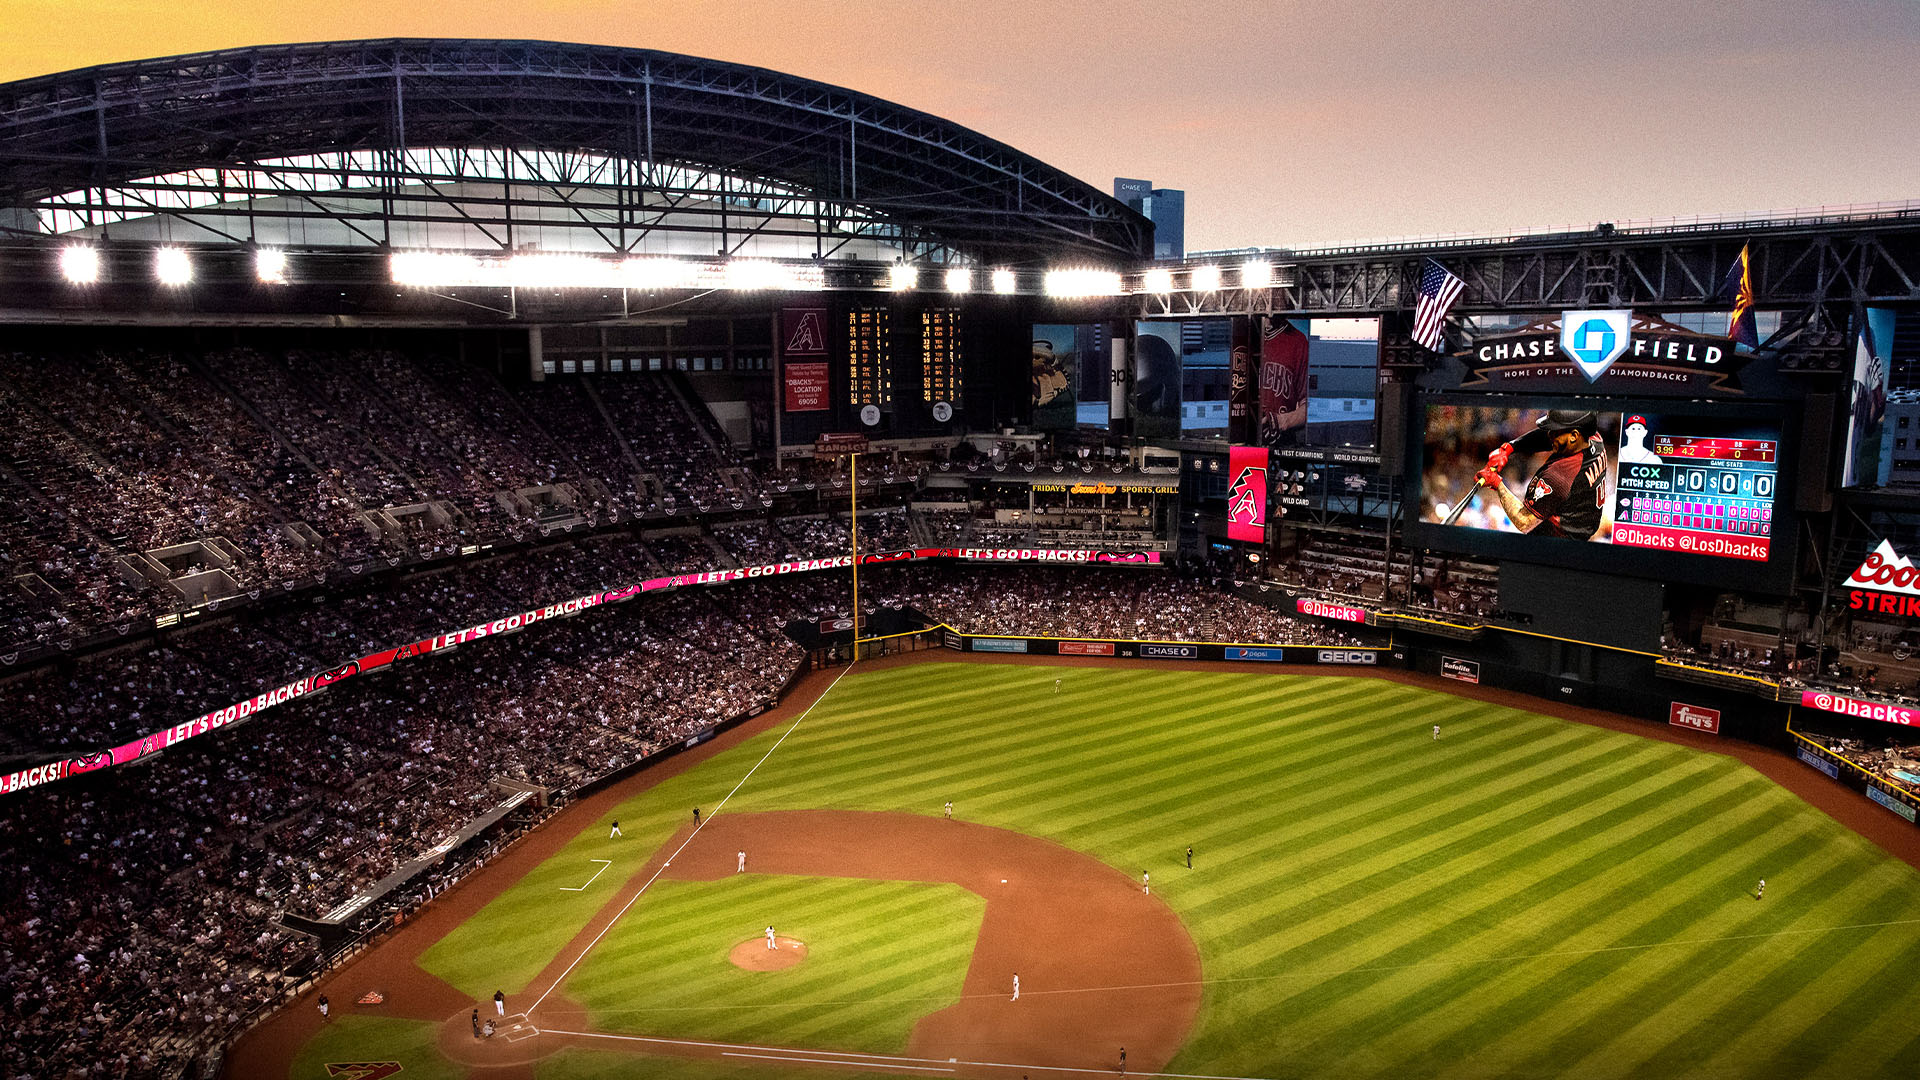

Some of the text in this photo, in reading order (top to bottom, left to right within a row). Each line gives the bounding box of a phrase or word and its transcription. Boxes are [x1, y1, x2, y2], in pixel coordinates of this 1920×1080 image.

[1479, 340, 1722, 363] CHASE FIELD
[1610, 369, 1688, 382] DIAMONDBACKS
[1656, 446, 1766, 460] 3.99 4.2 2 0 1
[1631, 467, 1660, 478] COX
[1621, 478, 1669, 489] PITCH SPEED
[1678, 475, 1685, 486] B
[1690, 472, 1702, 489] 0
[1710, 477, 1717, 488] S
[1722, 474, 1735, 492] 0
[1757, 477, 1770, 495] 0
[1644, 513, 1649, 521] 0
[1664, 515, 1669, 523] 0
[1764, 511, 1769, 519] 3
[1615, 529, 1767, 558] @Dbacks @LosDbacks
[958, 548, 1091, 562] LET'S GO D-BACKS!
[697, 569, 745, 584] LET'S
[747, 565, 776, 578] GO
[1850, 590, 1920, 617] STRIK
[1304, 602, 1357, 621] @Dbacks
[431, 595, 597, 651] LET'S GO D-BACKS!
[1148, 647, 1179, 655] CHASE
[1320, 652, 1375, 662] GEICO
[1444, 662, 1470, 672] Safelite
[166, 679, 309, 748] LET'S GO D-BACKS!
[1814, 694, 1911, 724] @Dbacks
[1677, 707, 1712, 728] fry's
[1872, 790, 1888, 805] COX
